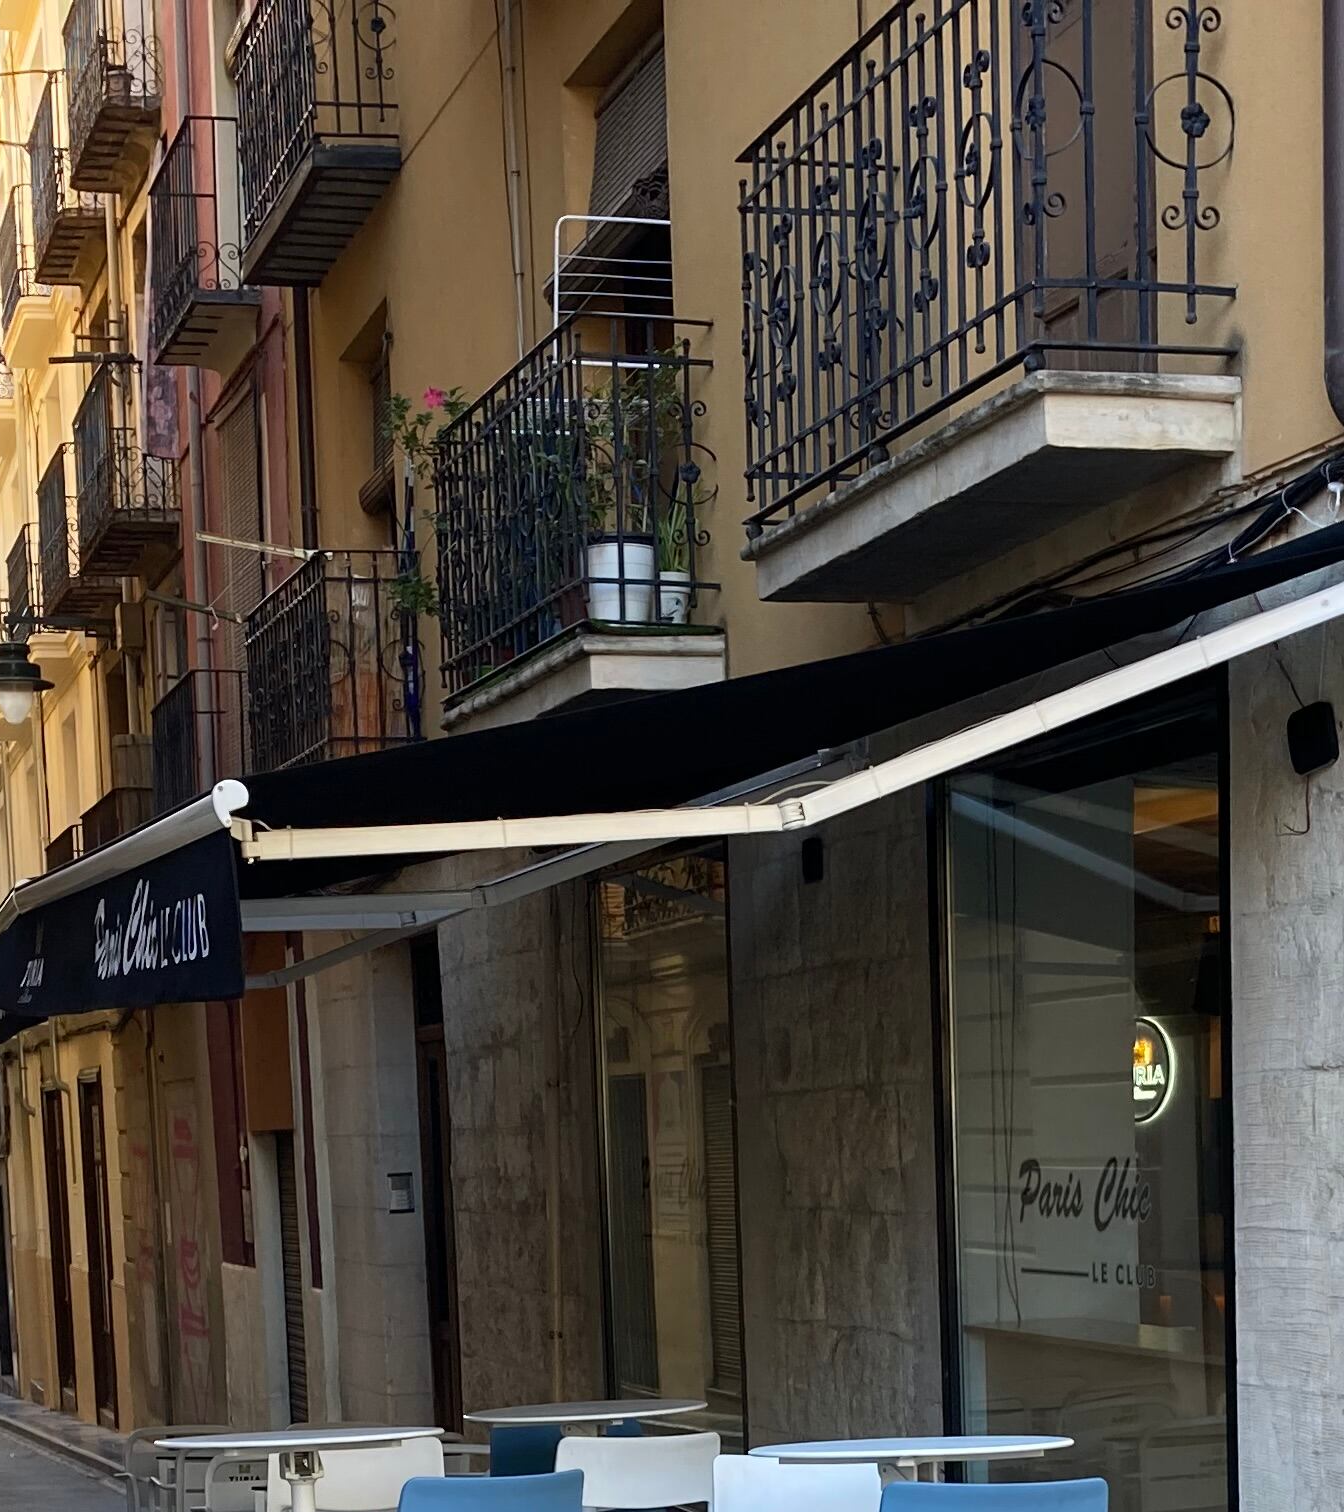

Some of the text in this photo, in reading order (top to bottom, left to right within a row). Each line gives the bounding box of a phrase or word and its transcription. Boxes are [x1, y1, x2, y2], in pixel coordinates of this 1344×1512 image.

[171, 893, 209, 964] CLUB
[1018, 1156, 1152, 1232] Paris Chic
[1092, 1261, 1156, 1289] LE CLUB
